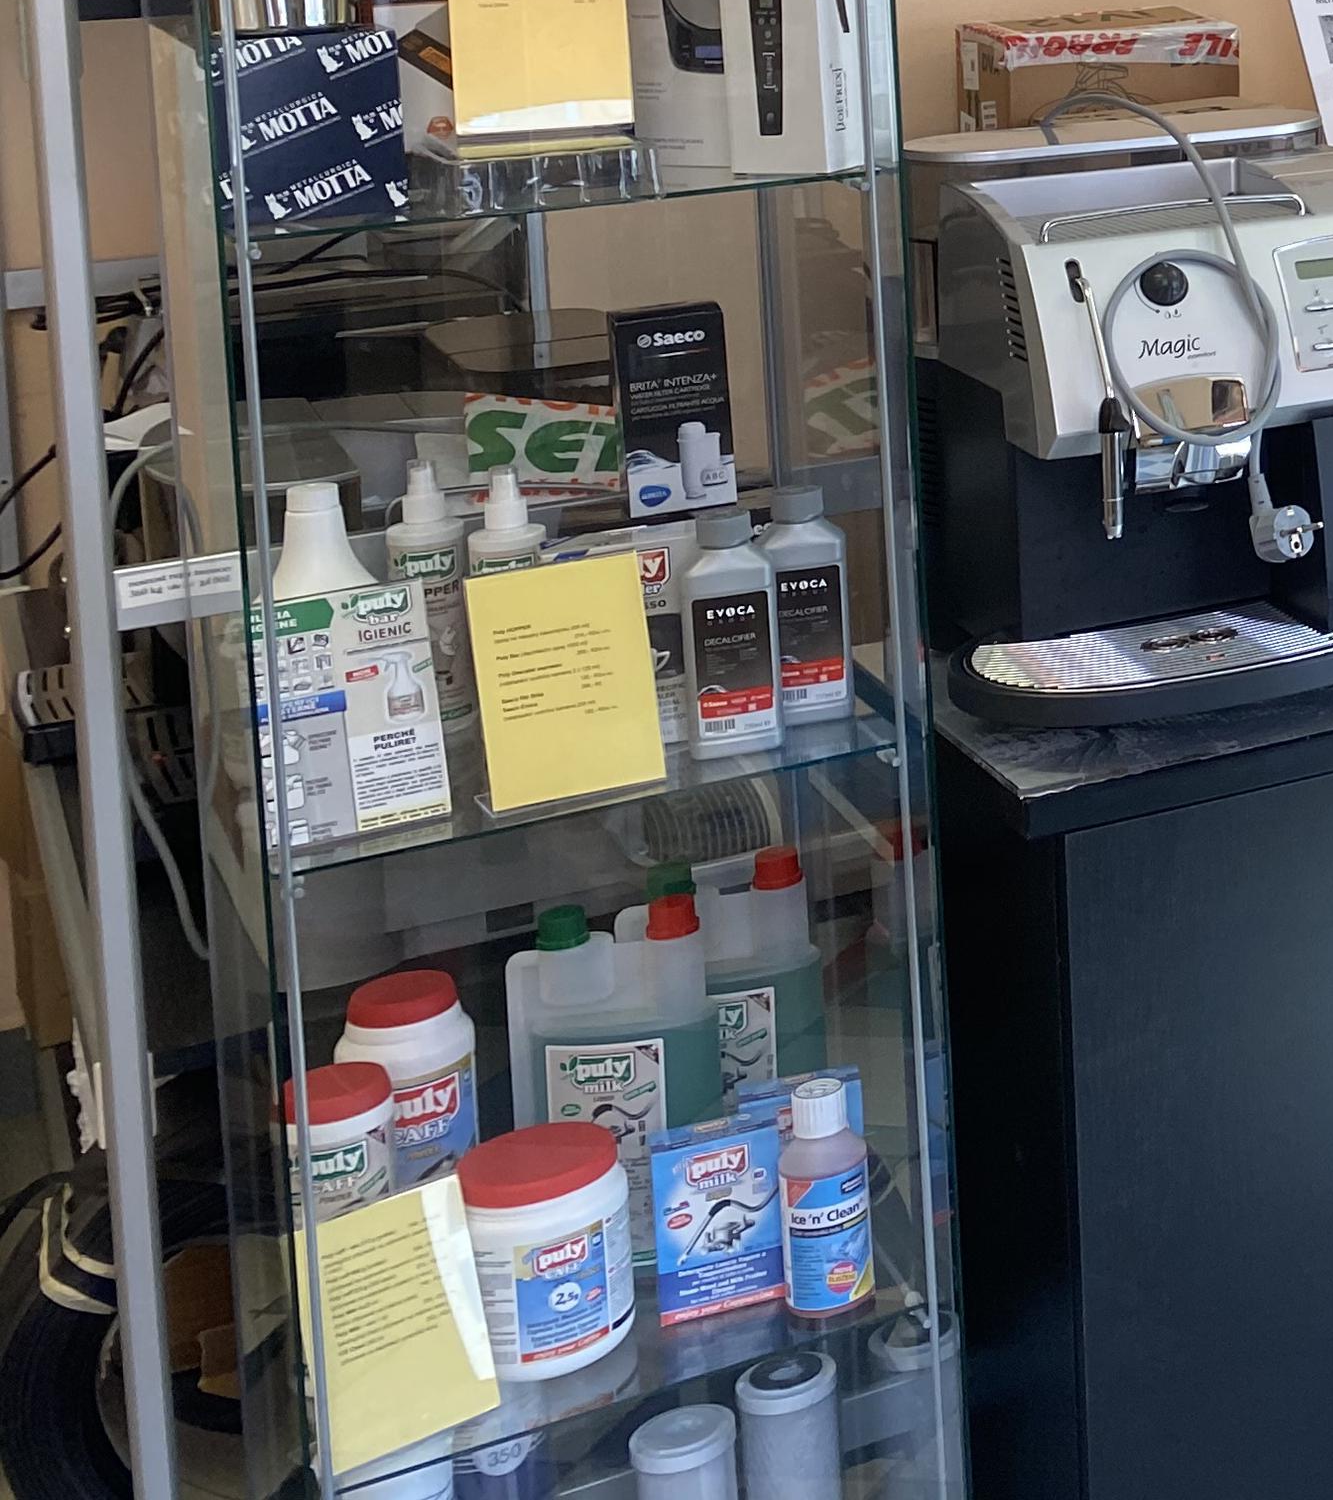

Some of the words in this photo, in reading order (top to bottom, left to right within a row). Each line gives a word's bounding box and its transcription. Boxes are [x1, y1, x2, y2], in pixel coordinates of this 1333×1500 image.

[254, 91, 324, 122] METALLURGICA
[258, 96, 339, 142] MOTTA
[289, 158, 359, 192] METALLURGICA
[293, 163, 373, 210] MOTTA
[653, 329, 706, 347] Saeco
[1137, 332, 1201, 359] Magic
[663, 372, 718, 388] INTENZA+
[405, 553, 456, 578] puly
[423, 579, 460, 598] PPER
[780, 578, 828, 593] EVOCA
[357, 588, 407, 616] puly
[706, 604, 756, 621] EVOCA
[367, 610, 399, 625] bar
[358, 621, 413, 643] IGIENIC
[703, 632, 757, 648] DECALCIFIER
[576, 1057, 630, 1082] puly
[583, 1080, 624, 1094] milk
[690, 1150, 745, 1179] puly
[697, 1172, 738, 1190] milk
[791, 1213, 807, 1225] Ice
[826, 1202, 860, 1222] Clean
[538, 1241, 584, 1270] puly
[487, 1442, 521, 1467] 350
